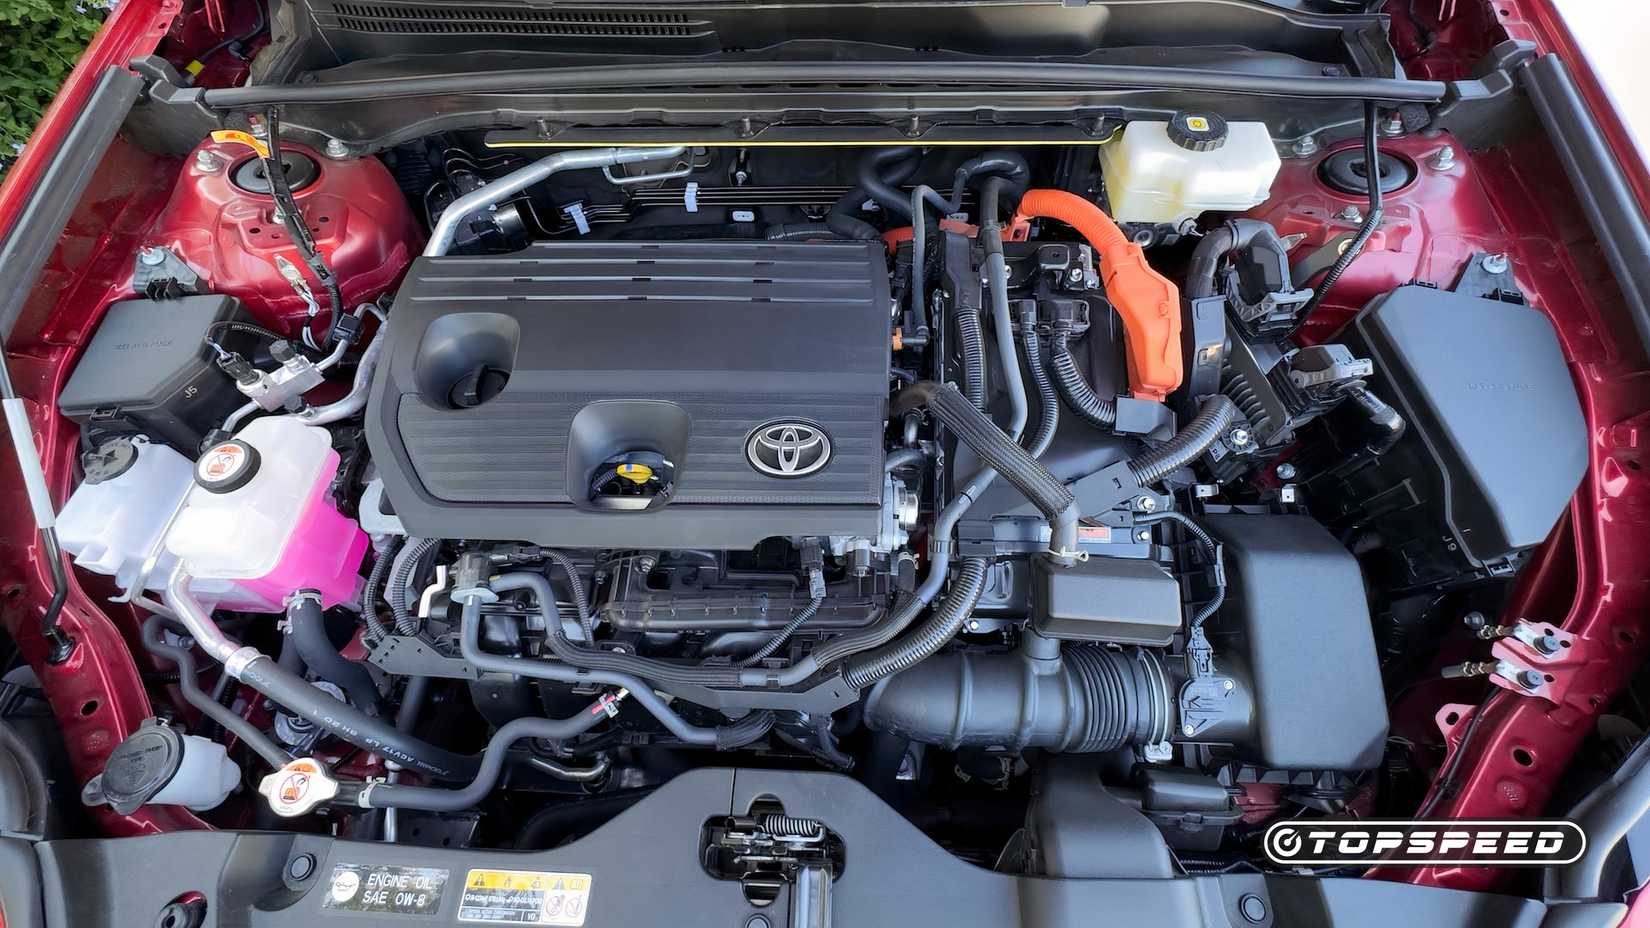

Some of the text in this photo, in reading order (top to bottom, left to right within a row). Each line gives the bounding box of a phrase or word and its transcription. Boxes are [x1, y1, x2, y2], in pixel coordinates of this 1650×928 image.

[185, 385, 198, 398] J5
[367, 873, 433, 889] ENGINE OIL
[362, 891, 388, 904] SAE
